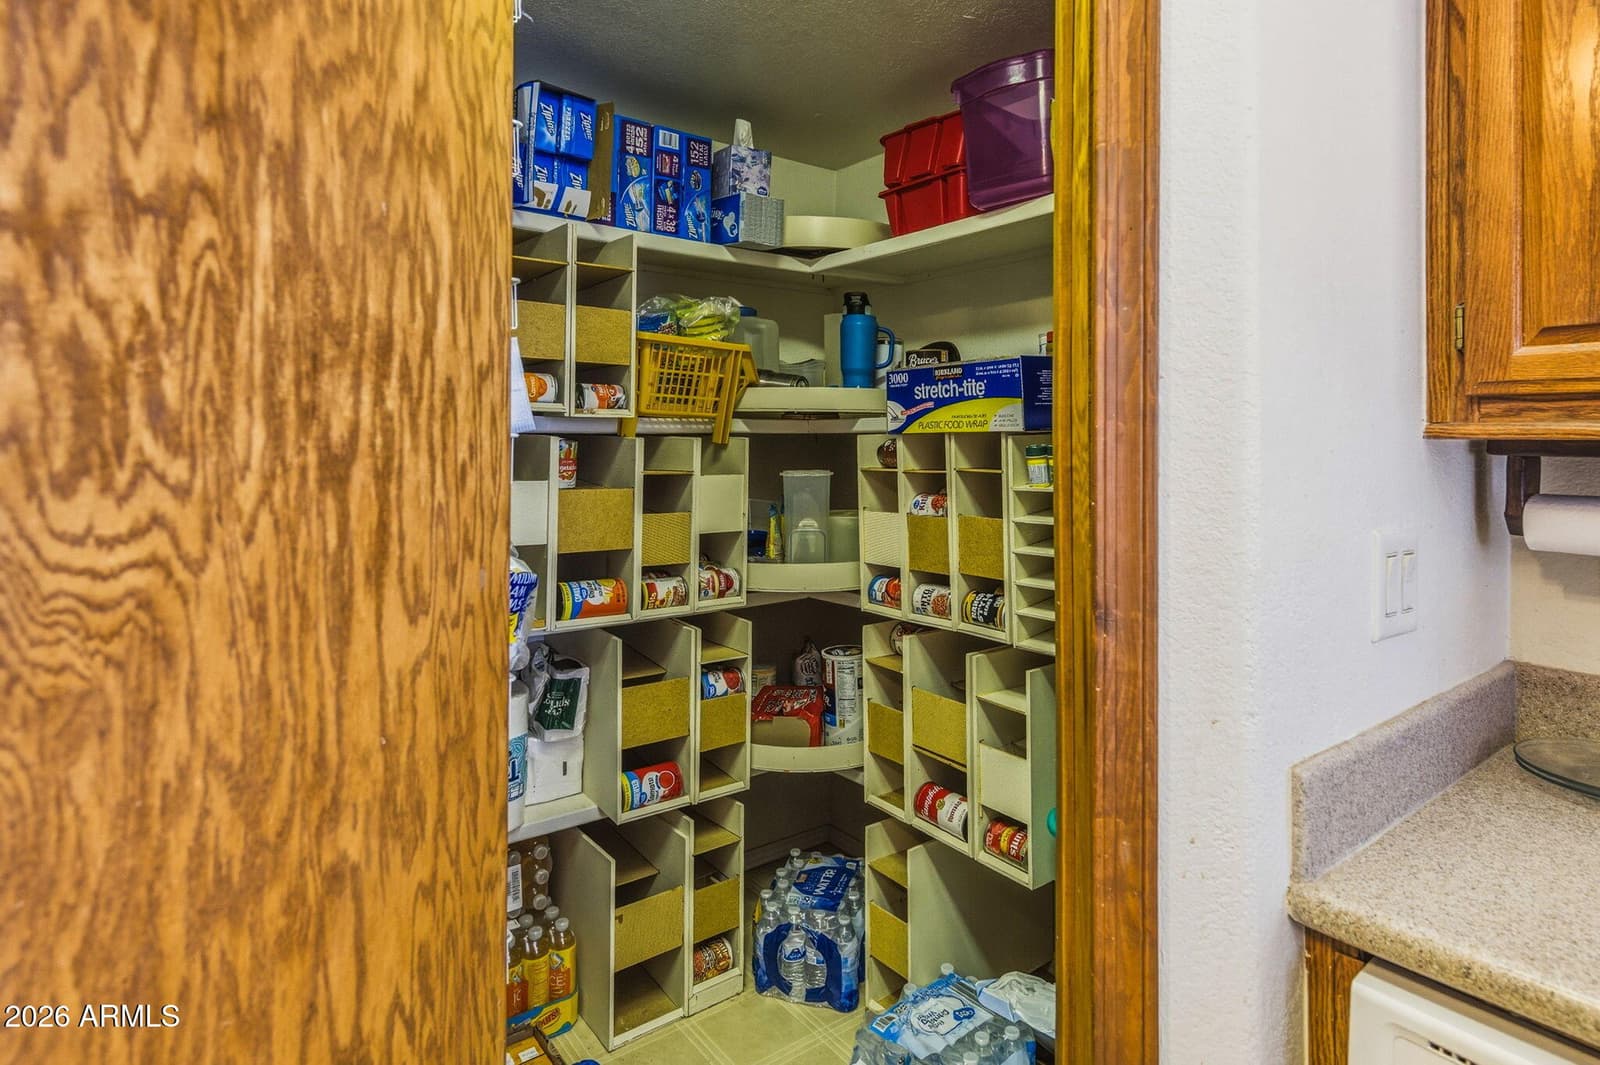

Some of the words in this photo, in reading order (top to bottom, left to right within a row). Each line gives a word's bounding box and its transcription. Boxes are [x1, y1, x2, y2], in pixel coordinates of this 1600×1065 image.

[540, 102, 555, 136] Ziploc
[635, 126, 645, 155] 152
[690, 141, 699, 164] 152
[666, 220, 676, 233] 38
[888, 372, 909, 385] 3000
[914, 378, 986, 399] stretch-tite
[918, 421, 942, 430] PLASTIC
[943, 420, 965, 430] FOOD
[965, 419, 989, 429] WRAP
